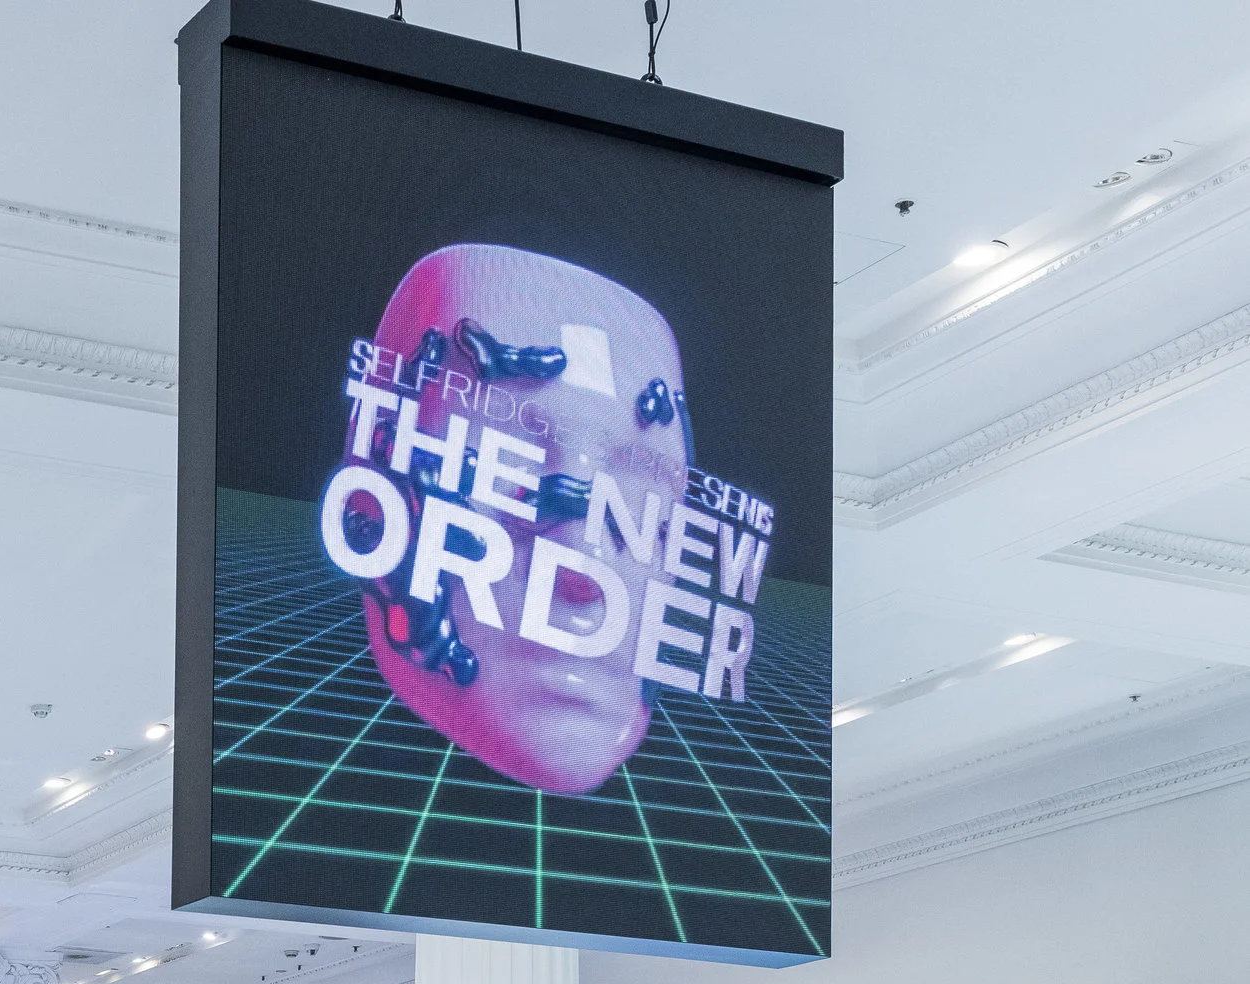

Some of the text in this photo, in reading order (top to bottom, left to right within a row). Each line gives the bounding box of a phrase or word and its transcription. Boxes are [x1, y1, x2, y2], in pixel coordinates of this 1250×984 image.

[345, 378, 770, 605] THE NEW
[349, 338, 551, 437] SELFRIDG
[321, 465, 756, 702] ORDER
